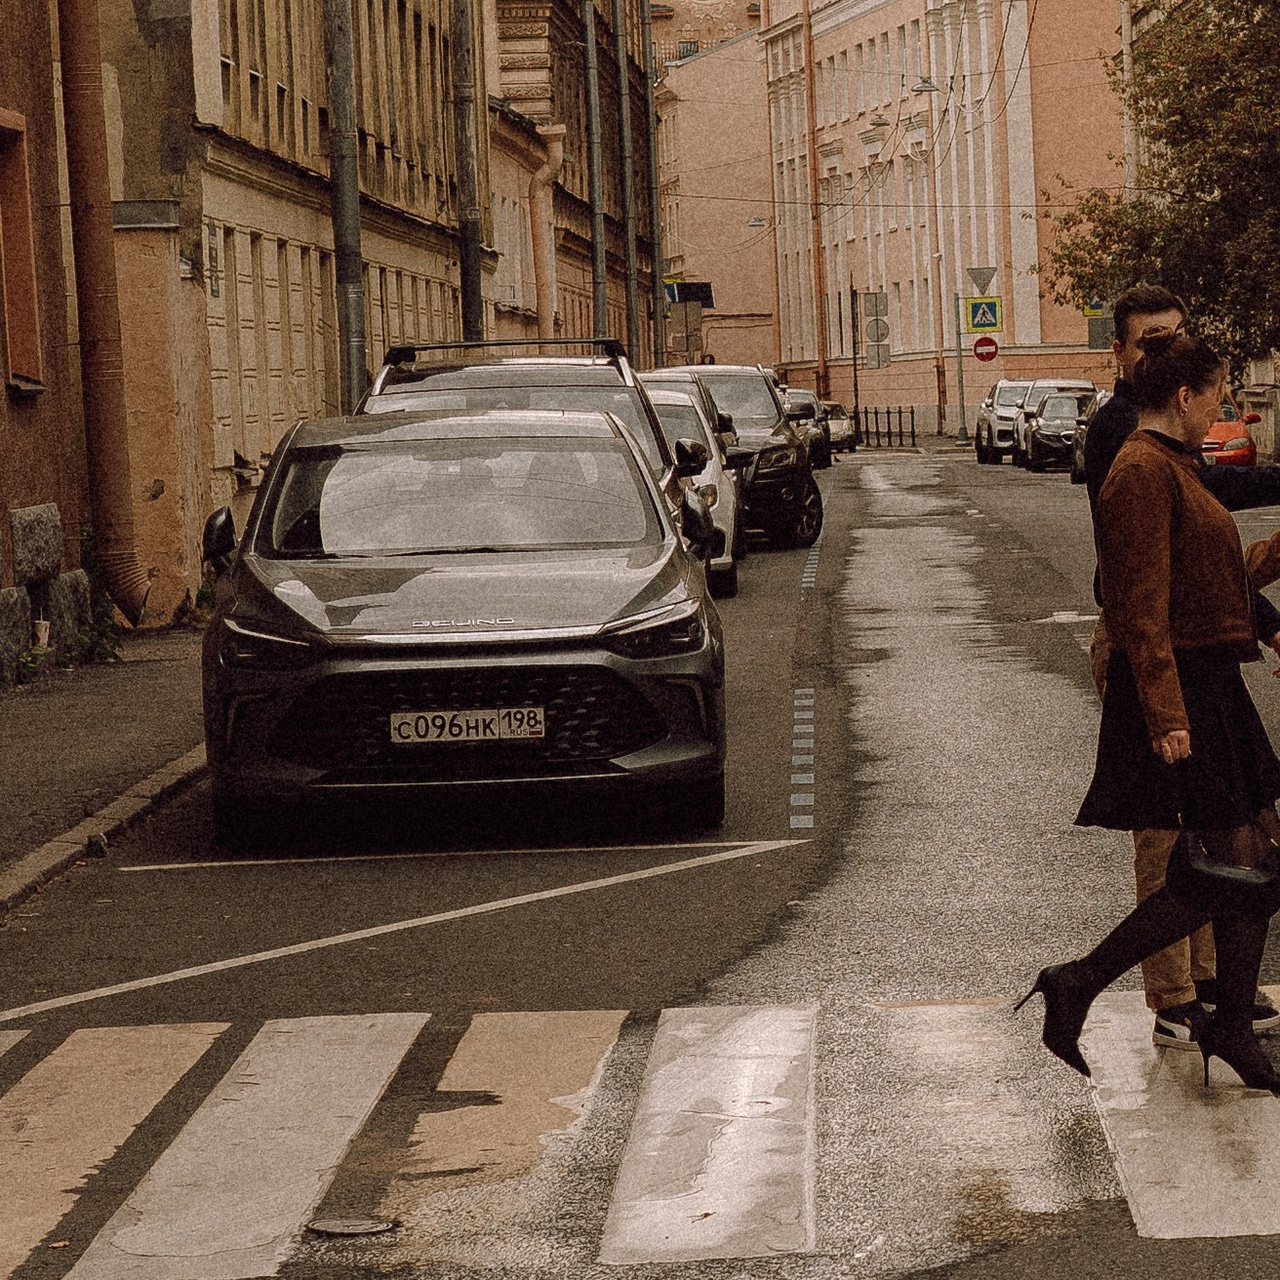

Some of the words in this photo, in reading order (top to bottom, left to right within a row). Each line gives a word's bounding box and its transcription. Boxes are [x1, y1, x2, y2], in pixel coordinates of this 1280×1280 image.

[397, 714, 497, 739] С096НК
[501, 710, 538, 729] 198
[509, 728, 529, 736] RUS
